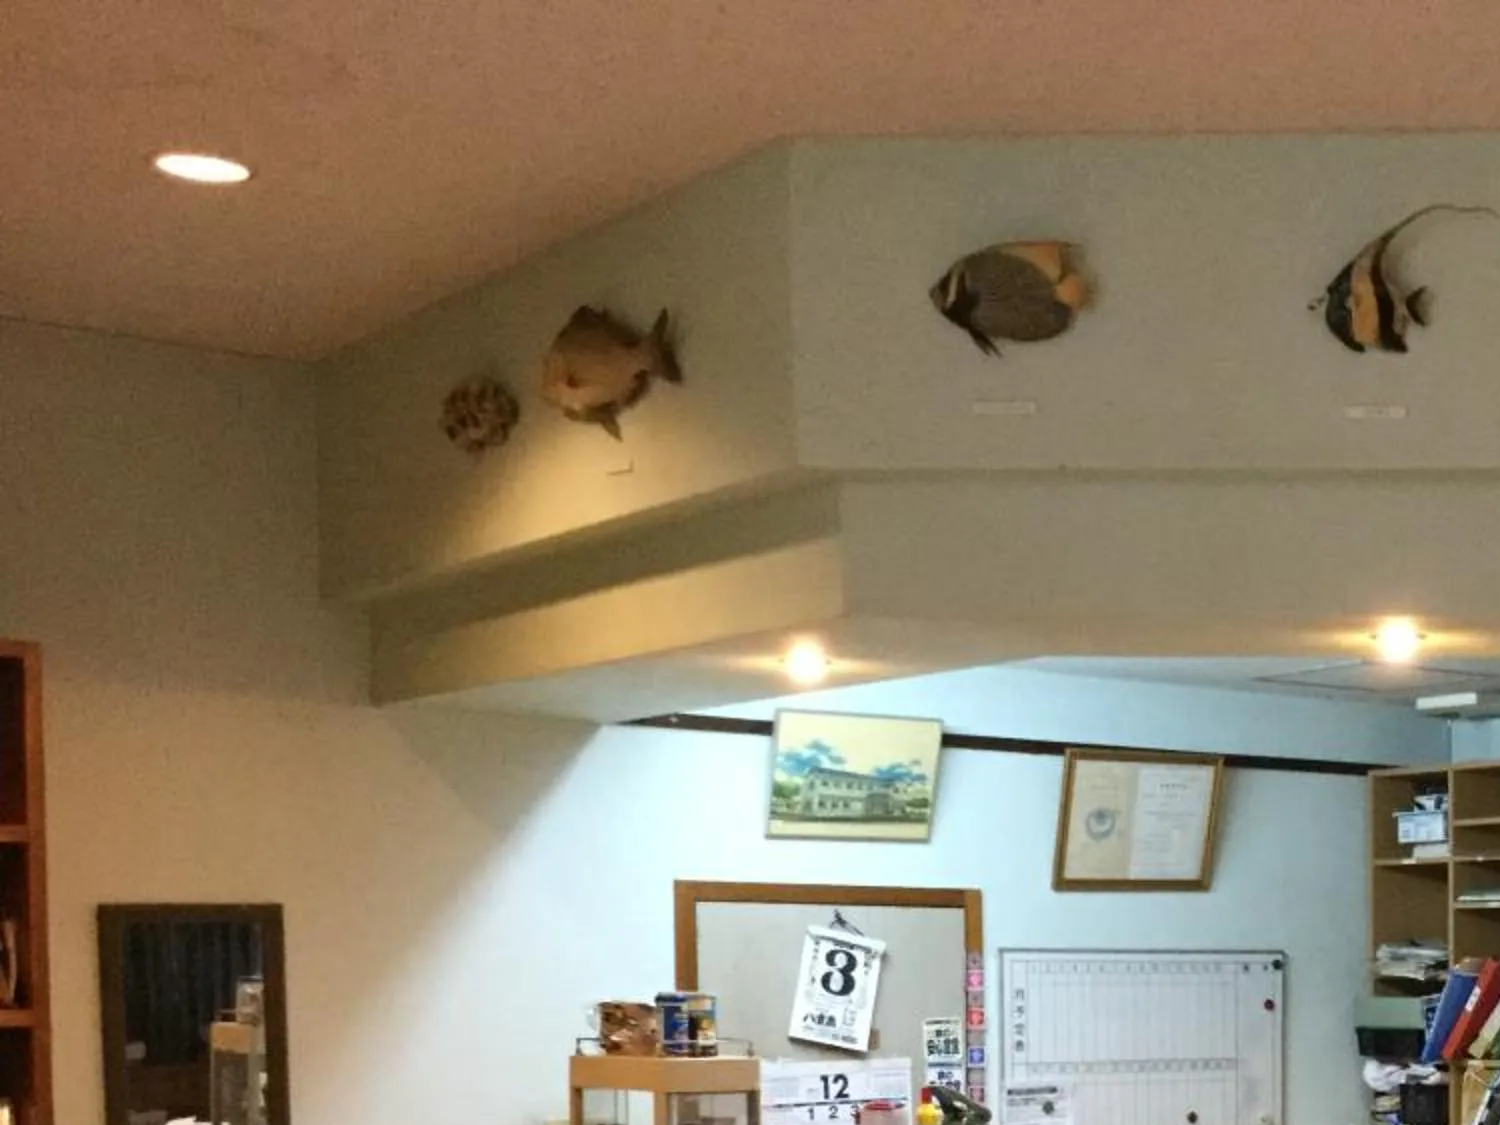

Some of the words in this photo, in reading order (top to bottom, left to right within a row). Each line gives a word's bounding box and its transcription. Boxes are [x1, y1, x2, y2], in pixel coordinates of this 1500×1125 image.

[819, 1073, 850, 1101] 12
[807, 1107, 816, 1121] 1
[828, 1105, 839, 1120] 2
